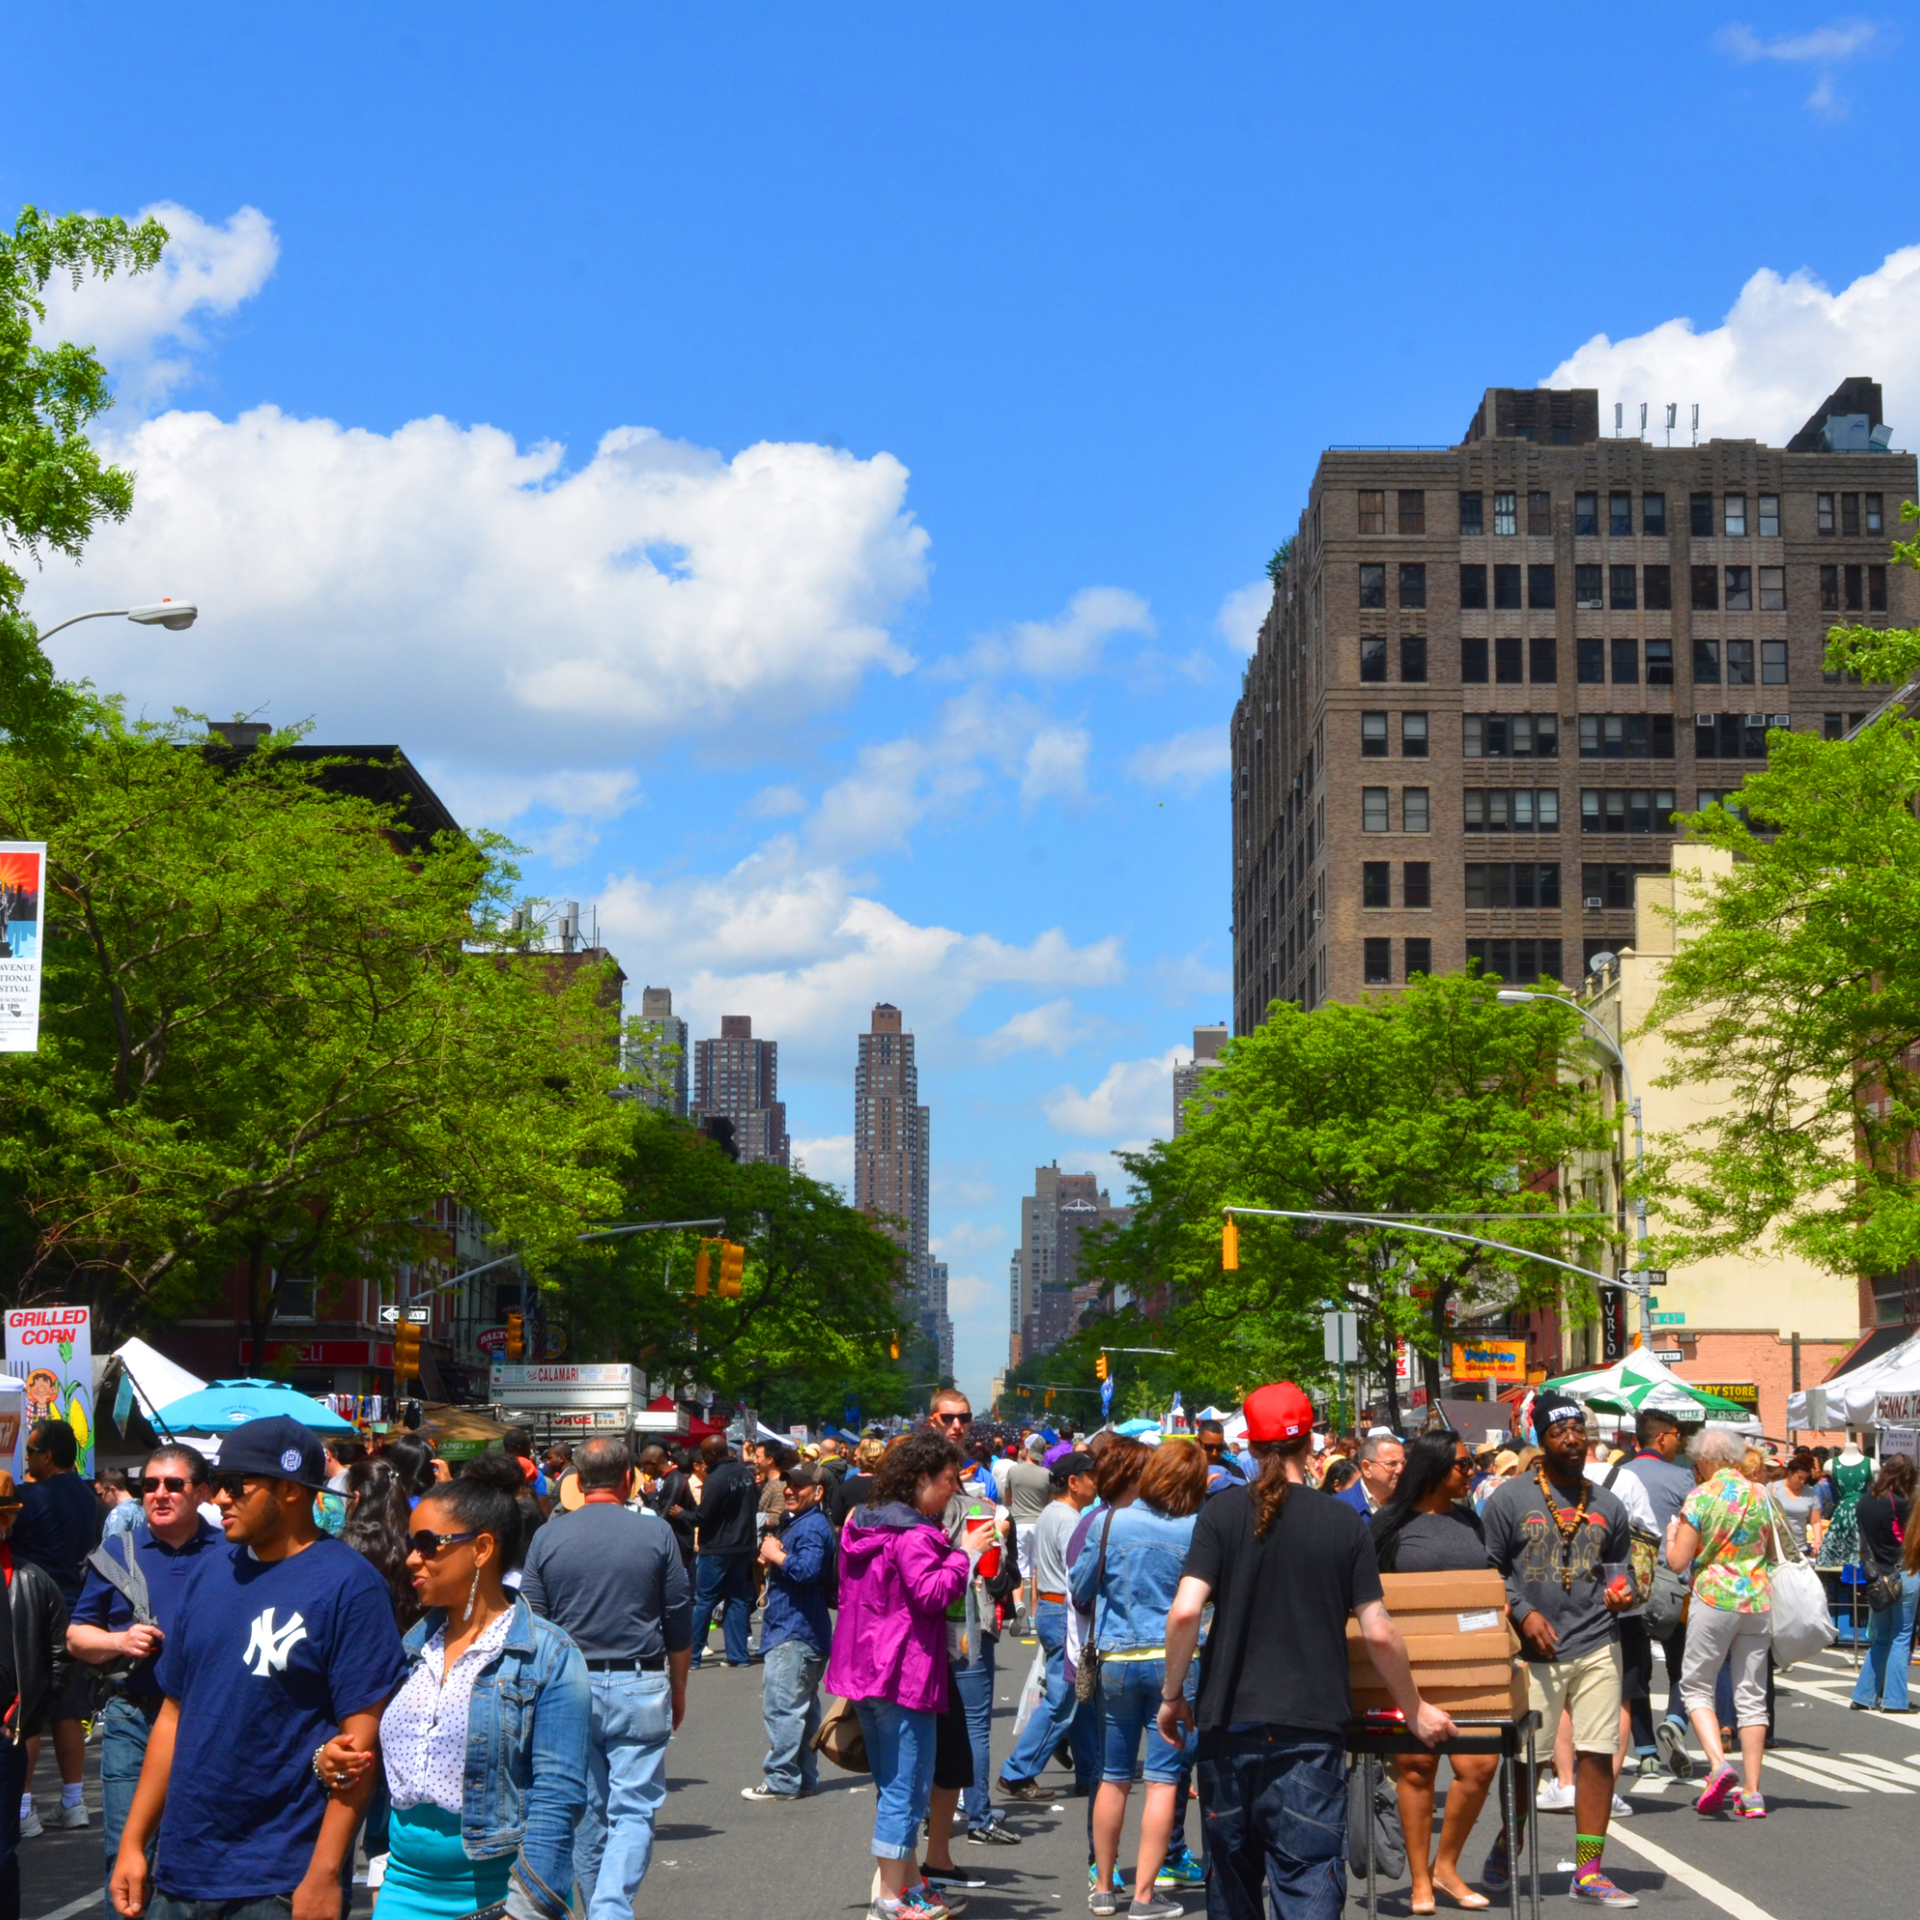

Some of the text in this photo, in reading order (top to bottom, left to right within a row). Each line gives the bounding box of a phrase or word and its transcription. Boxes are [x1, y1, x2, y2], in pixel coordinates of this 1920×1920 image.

[9, 1309, 88, 1328] GRILLED
[22, 1328, 76, 1346] CORN
[1465, 1350, 1515, 1362] Patron
[538, 1367, 578, 1382] CALAMARI
[1722, 1386, 1756, 1396] STORE
[242, 1606, 308, 1678] NY
